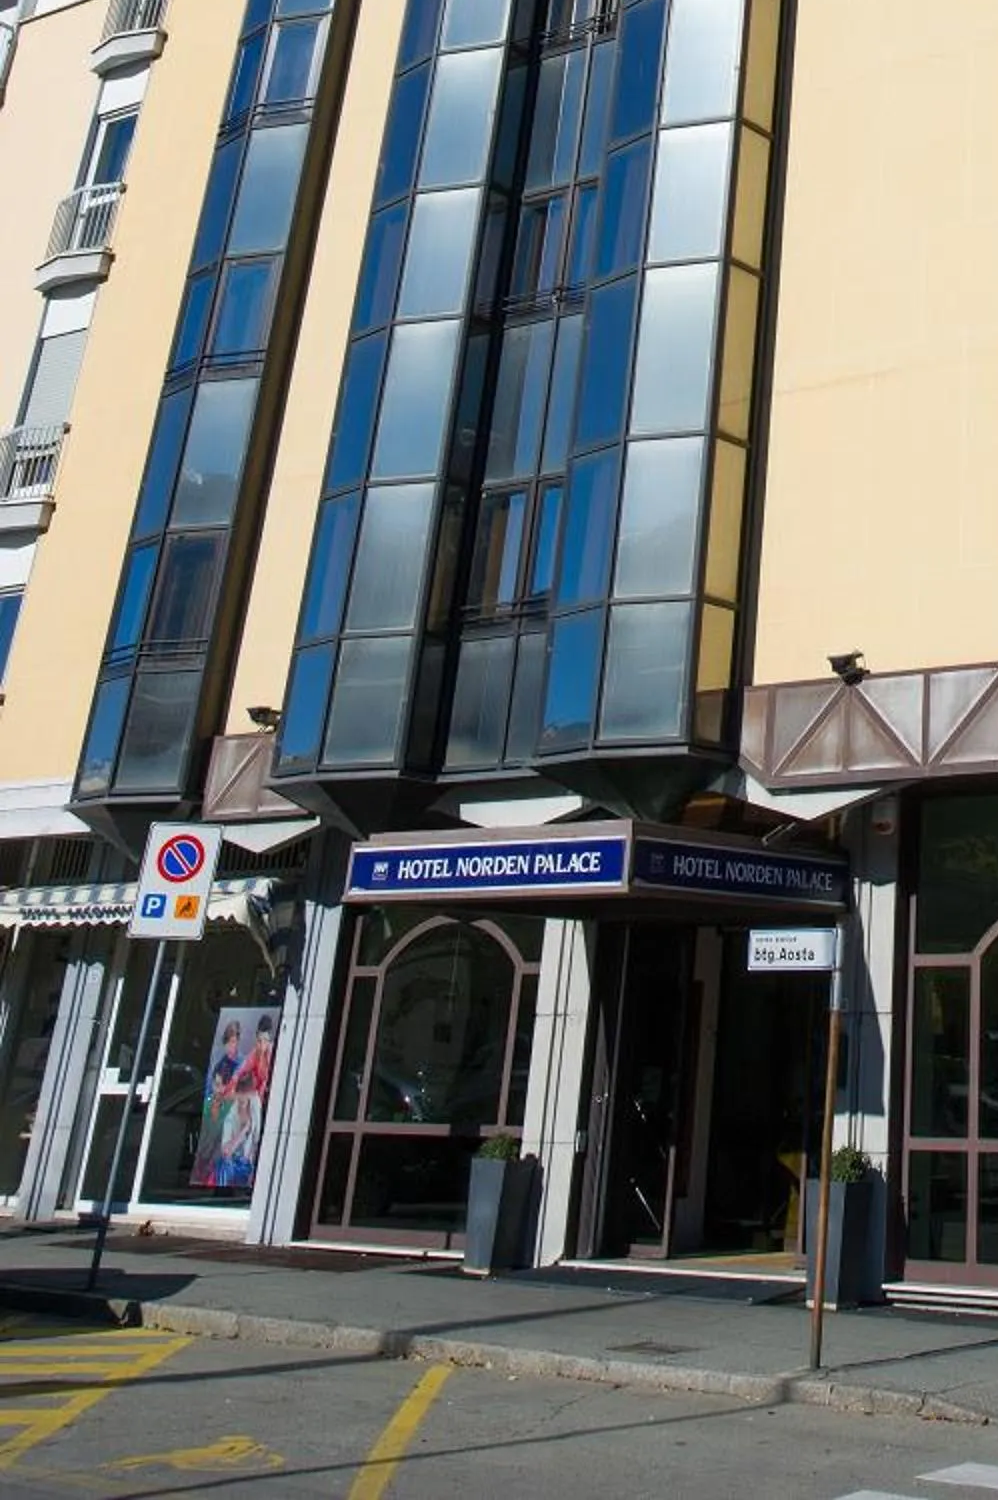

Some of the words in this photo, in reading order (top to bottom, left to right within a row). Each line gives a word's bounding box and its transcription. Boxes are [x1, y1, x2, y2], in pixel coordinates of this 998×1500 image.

[397, 858, 453, 880] HOTEL
[455, 854, 530, 878] NORDEN
[533, 851, 601, 875] PALACE
[672, 855, 722, 880] HOTEL
[724, 861, 784, 886] NORDEN
[785, 866, 834, 892] PALACE
[145, 896, 161, 916] P
